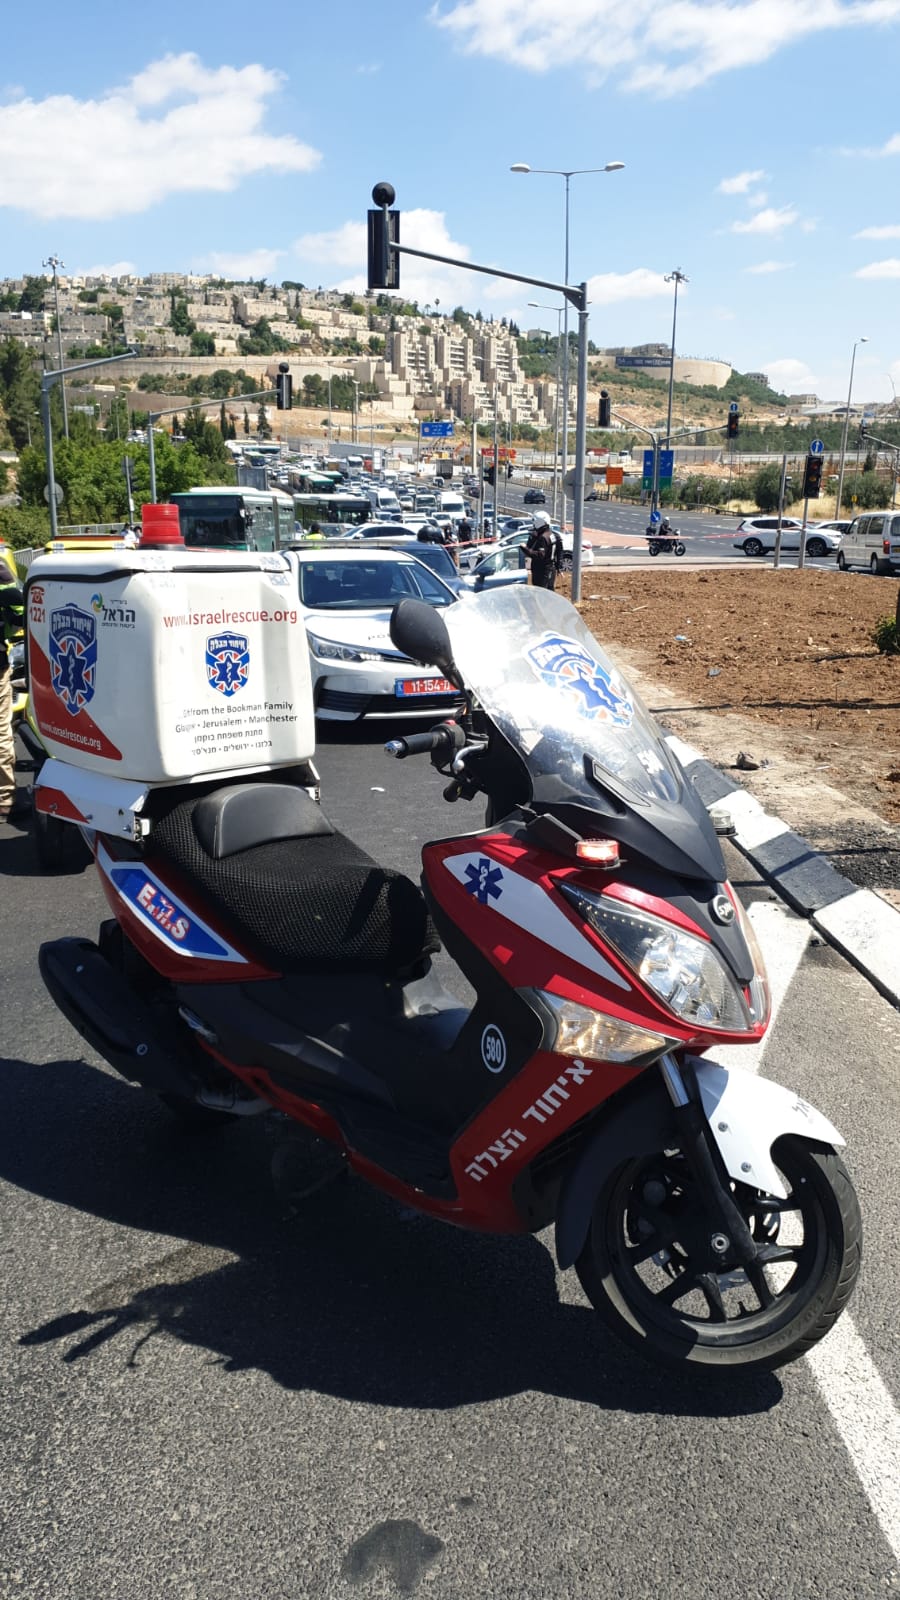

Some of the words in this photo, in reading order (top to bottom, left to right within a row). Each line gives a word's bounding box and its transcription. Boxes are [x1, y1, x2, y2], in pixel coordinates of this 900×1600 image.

[30, 606, 46, 624] 1221
[102, 605, 135, 622] הראל
[211, 706, 225, 714] the
[227, 703, 262, 713] Bookman
[264, 701, 294, 712] Family
[202, 717, 242, 729] Jerusalem
[248, 714, 298, 724] Manchester
[485, 1036, 502, 1064] 580
[521, 1059, 593, 1124] איחוד
[464, 1128, 527, 1182] הצלה
